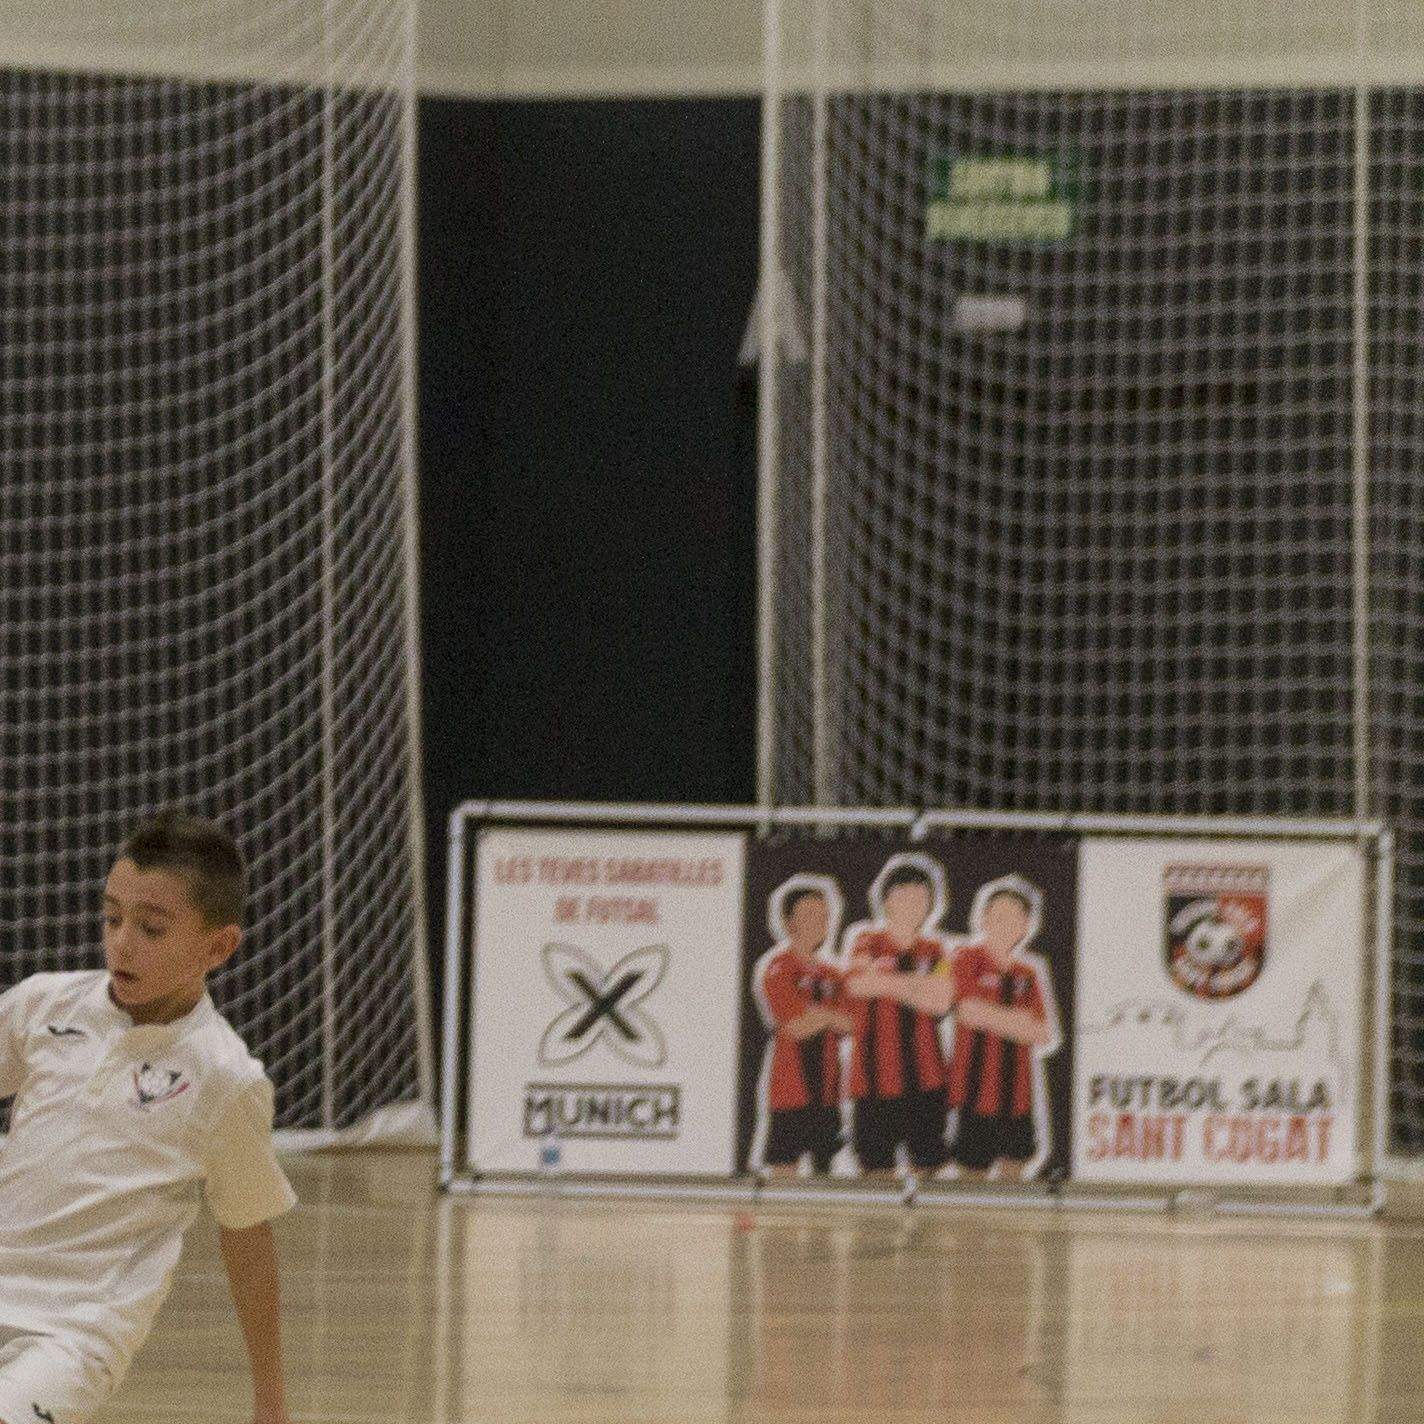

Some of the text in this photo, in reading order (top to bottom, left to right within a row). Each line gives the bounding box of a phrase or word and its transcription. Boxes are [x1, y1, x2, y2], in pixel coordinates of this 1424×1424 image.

[494, 857, 532, 884] LES
[523, 1092, 681, 1134] MUNICH
[1087, 1074, 1332, 1112] FUTBOL SALA
[1087, 1113, 1335, 1164] SANT CUGAT
